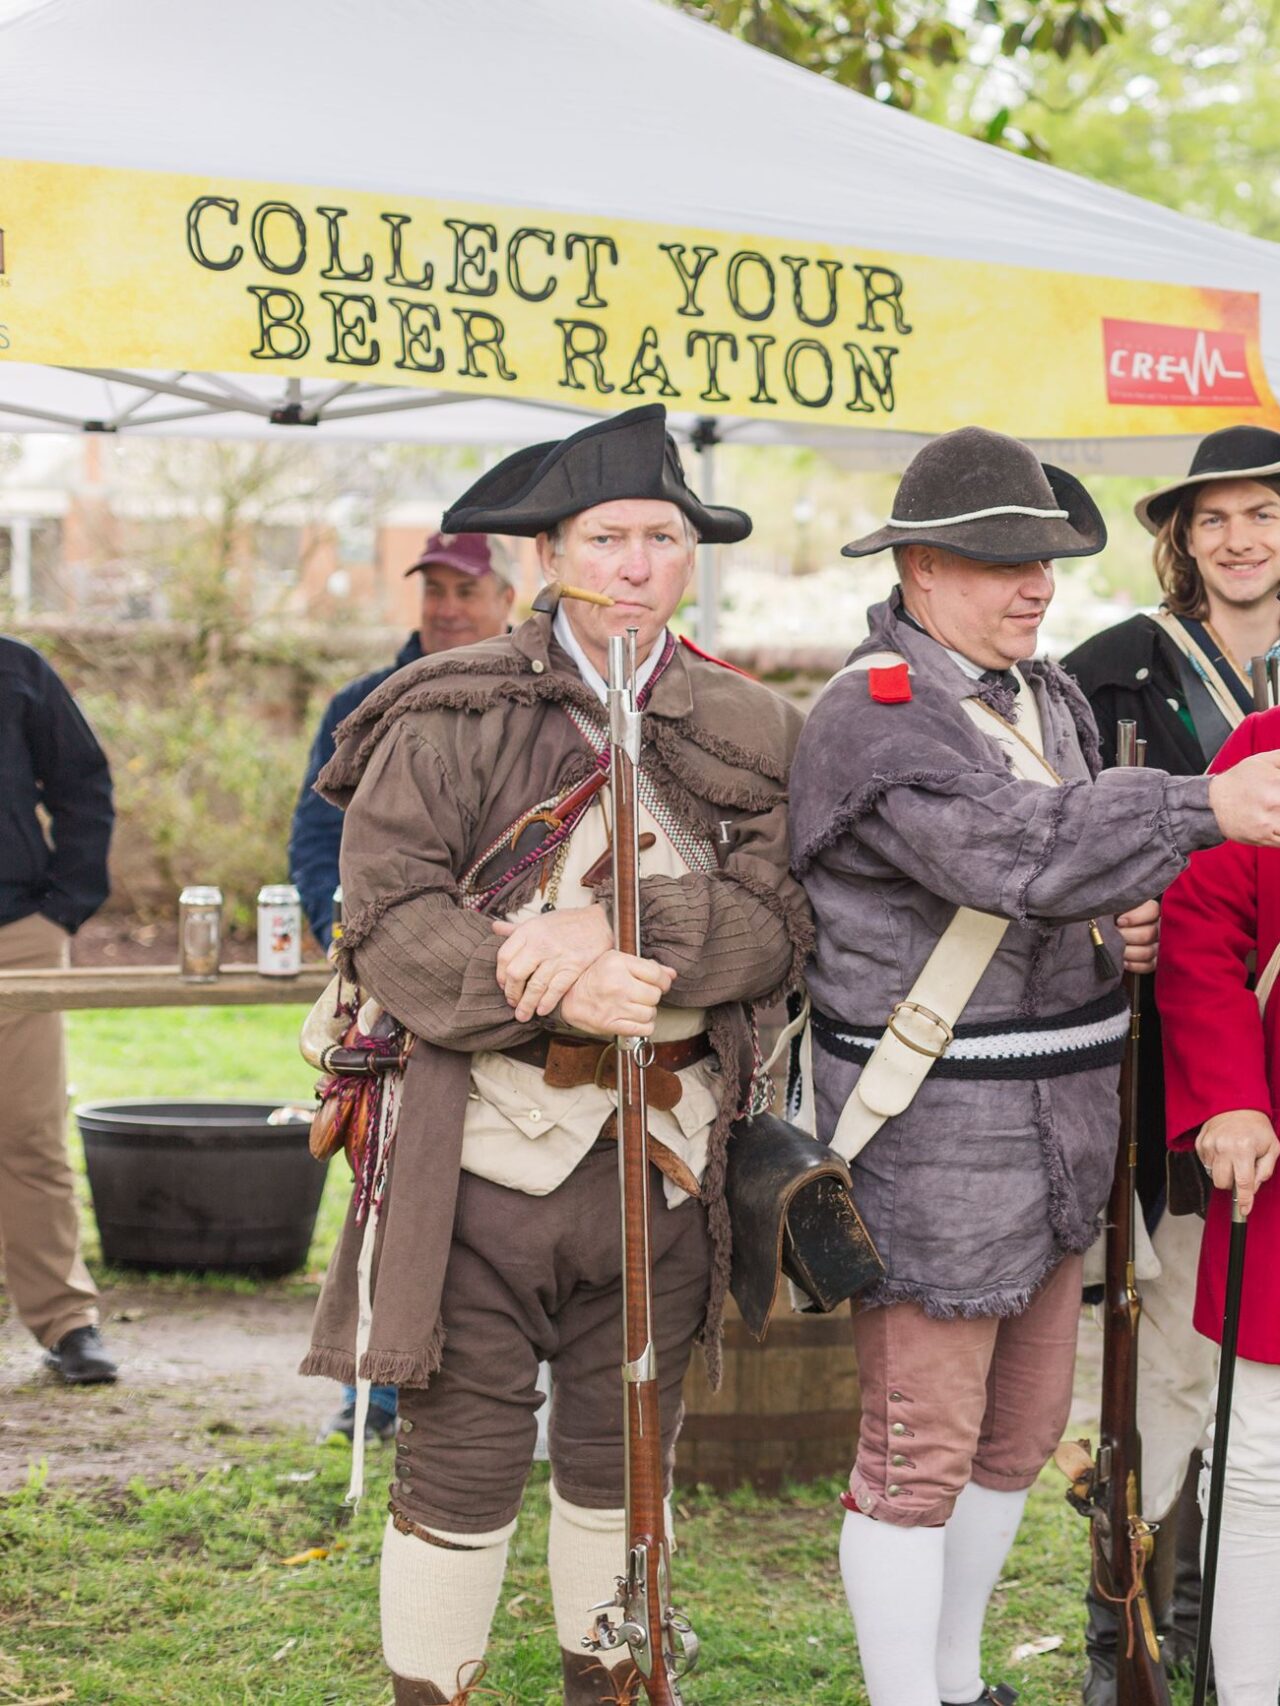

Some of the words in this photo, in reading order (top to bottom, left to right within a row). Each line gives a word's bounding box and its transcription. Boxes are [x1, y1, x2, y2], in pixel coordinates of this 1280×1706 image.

[186, 196, 619, 309] COLLECT
[658, 243, 913, 335] YOUR
[246, 285, 518, 381] BEER
[554, 318, 899, 413] RATION
